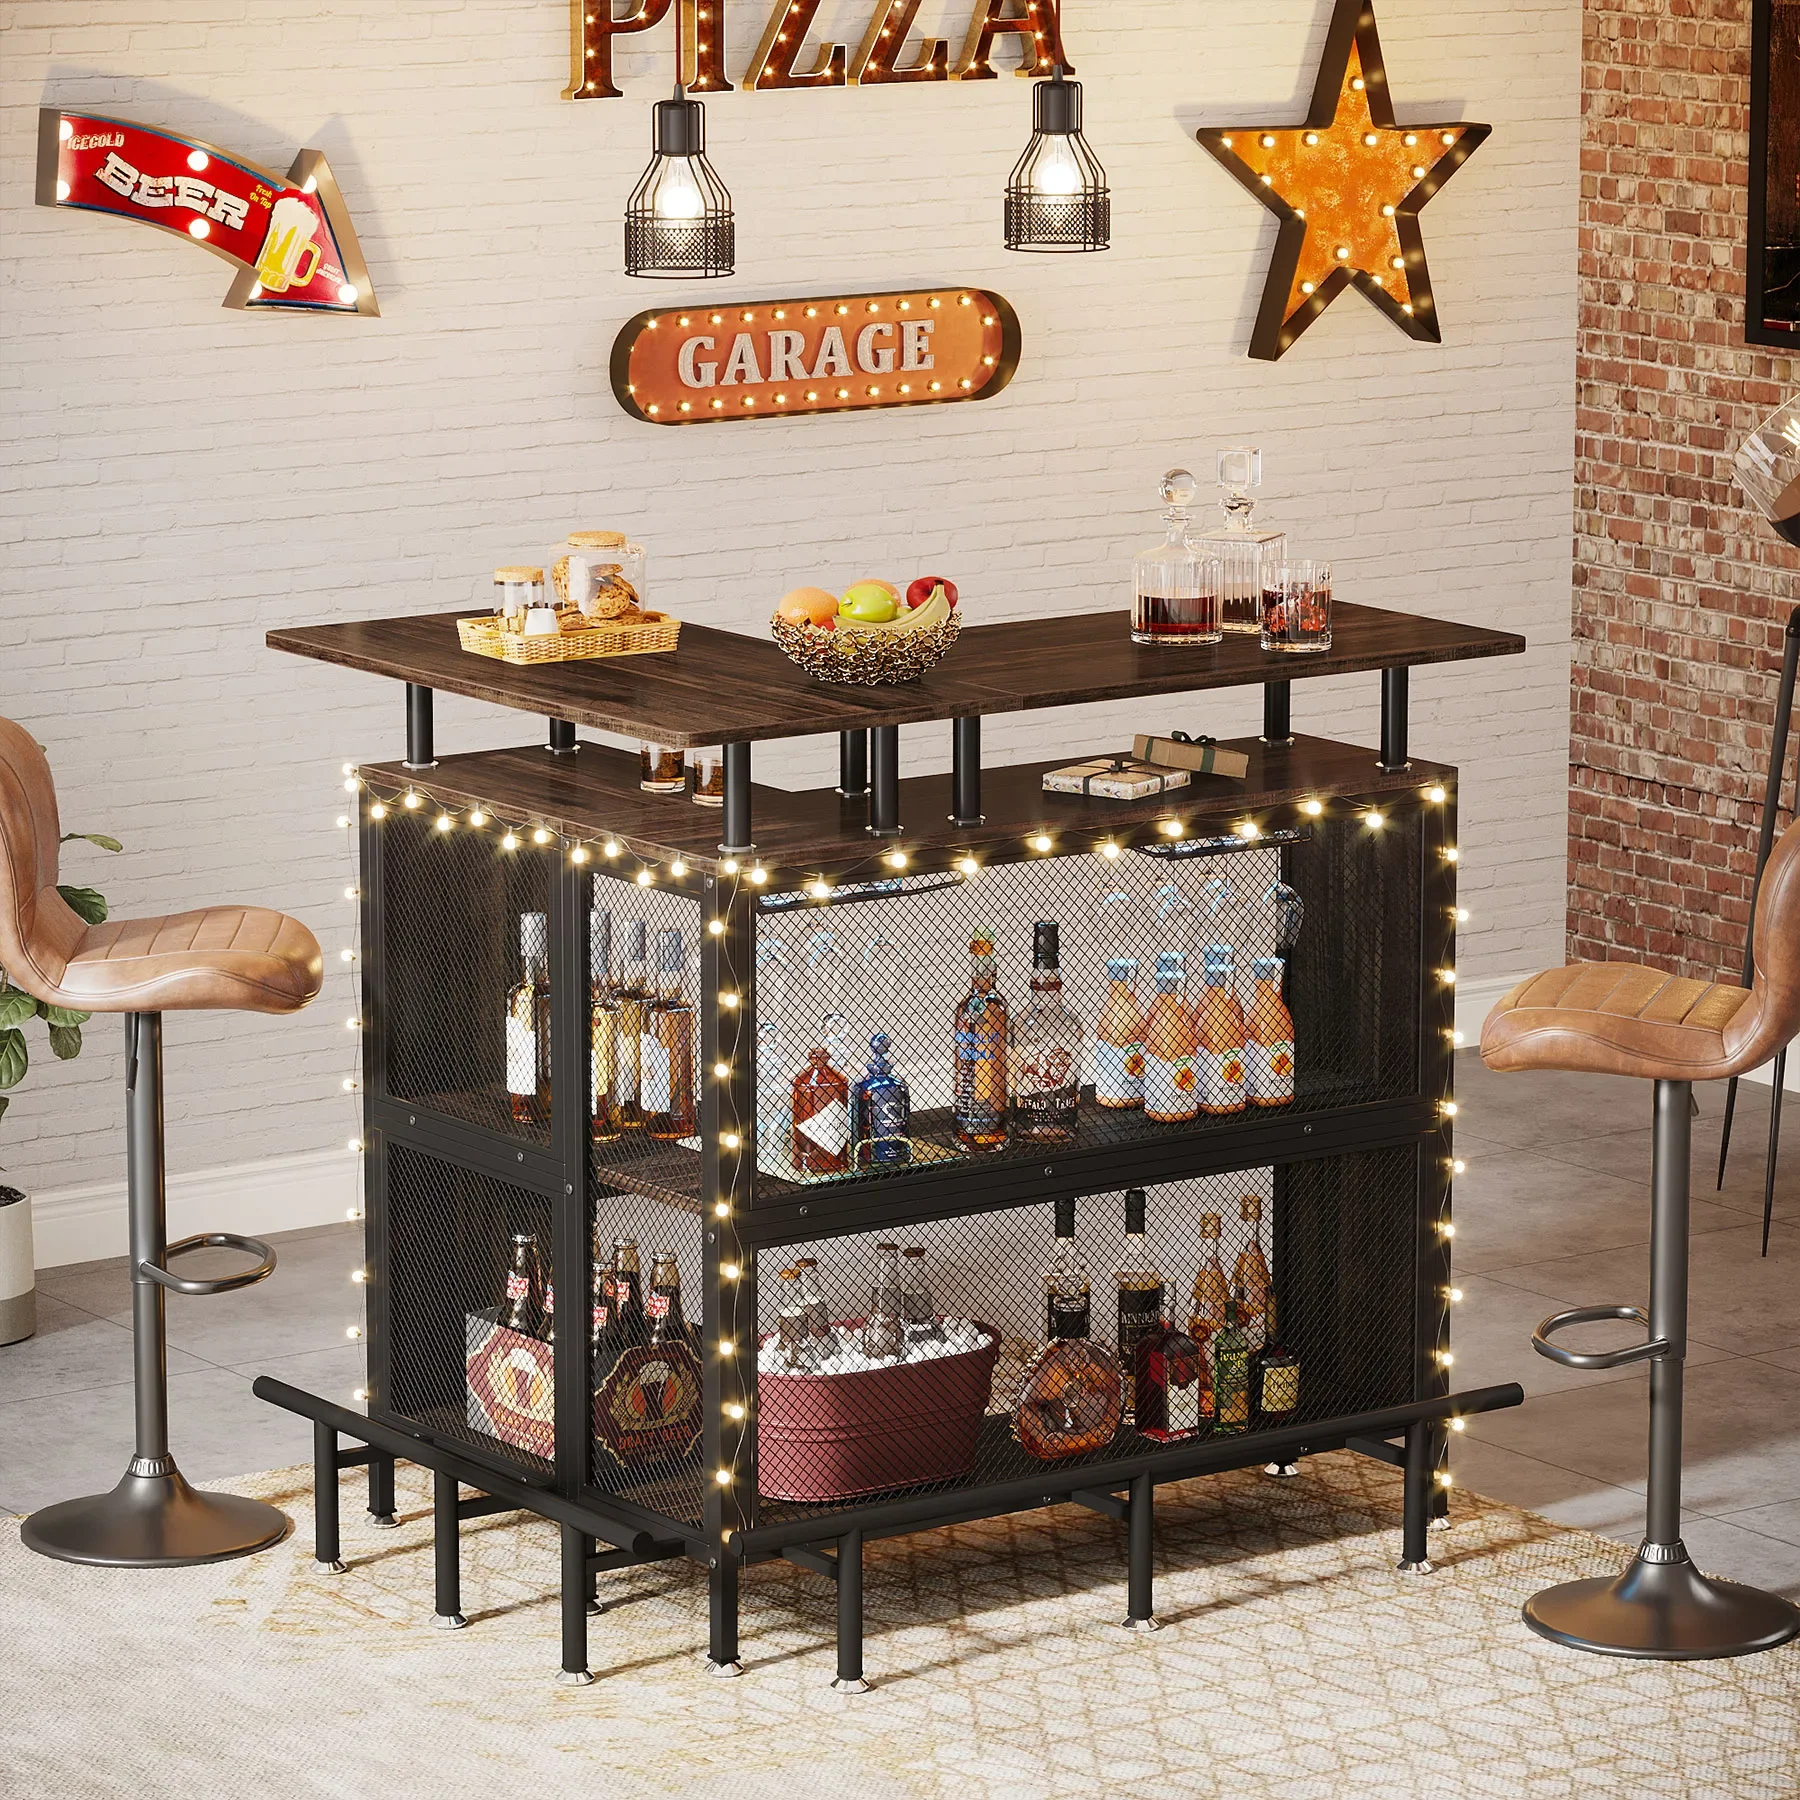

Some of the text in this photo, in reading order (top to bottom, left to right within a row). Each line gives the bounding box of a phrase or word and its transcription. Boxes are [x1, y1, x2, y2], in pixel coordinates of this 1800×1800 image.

[561, 0, 1076, 100] PIZZA
[93, 151, 250, 231] BEER
[249, 192, 273, 210] On Tap
[255, 184, 273, 199] Fresh
[677, 318, 936, 390] GARAGE
